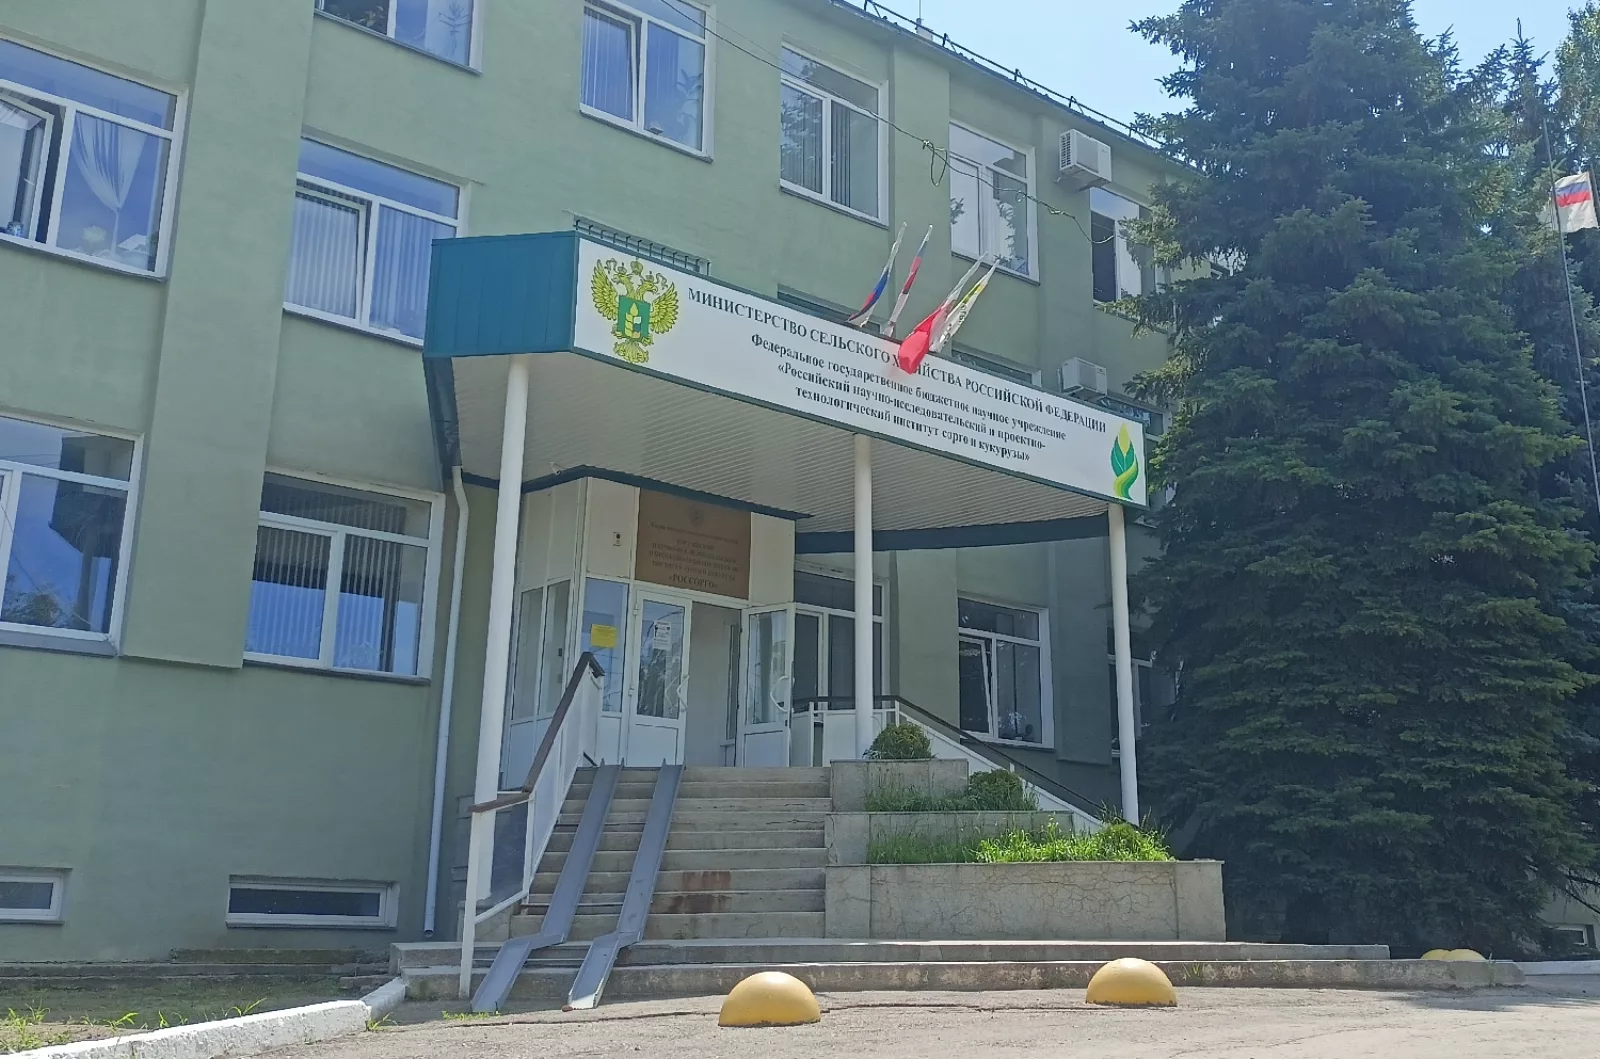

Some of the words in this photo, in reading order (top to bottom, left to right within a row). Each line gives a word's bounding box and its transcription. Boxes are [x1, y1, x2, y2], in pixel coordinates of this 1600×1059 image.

[688, 287, 807, 338] МИНИСТЕРСТВО
[810, 329, 890, 364] СЕЛЬСКОГО
[965, 378, 1043, 413] РОССИЙСКОЙ
[1045, 405, 1107, 433] ФЕДЕРАЦИИ
[751, 333, 825, 368] Федеральное
[828, 361, 913, 396] государственное
[915, 386, 970, 413] бюджетное
[972, 406, 1009, 426] научное
[1011, 417, 1066, 441] учреждение
[778, 361, 850, 393] «Российский
[853, 384, 987, 434] научно-исследовательский
[998, 430, 1046, 450] проектно-
[796, 385, 891, 422] технологический
[893, 414, 939, 438] институт
[942, 430, 968, 446] сорго
[978, 440, 1030, 462] кукурузы»
